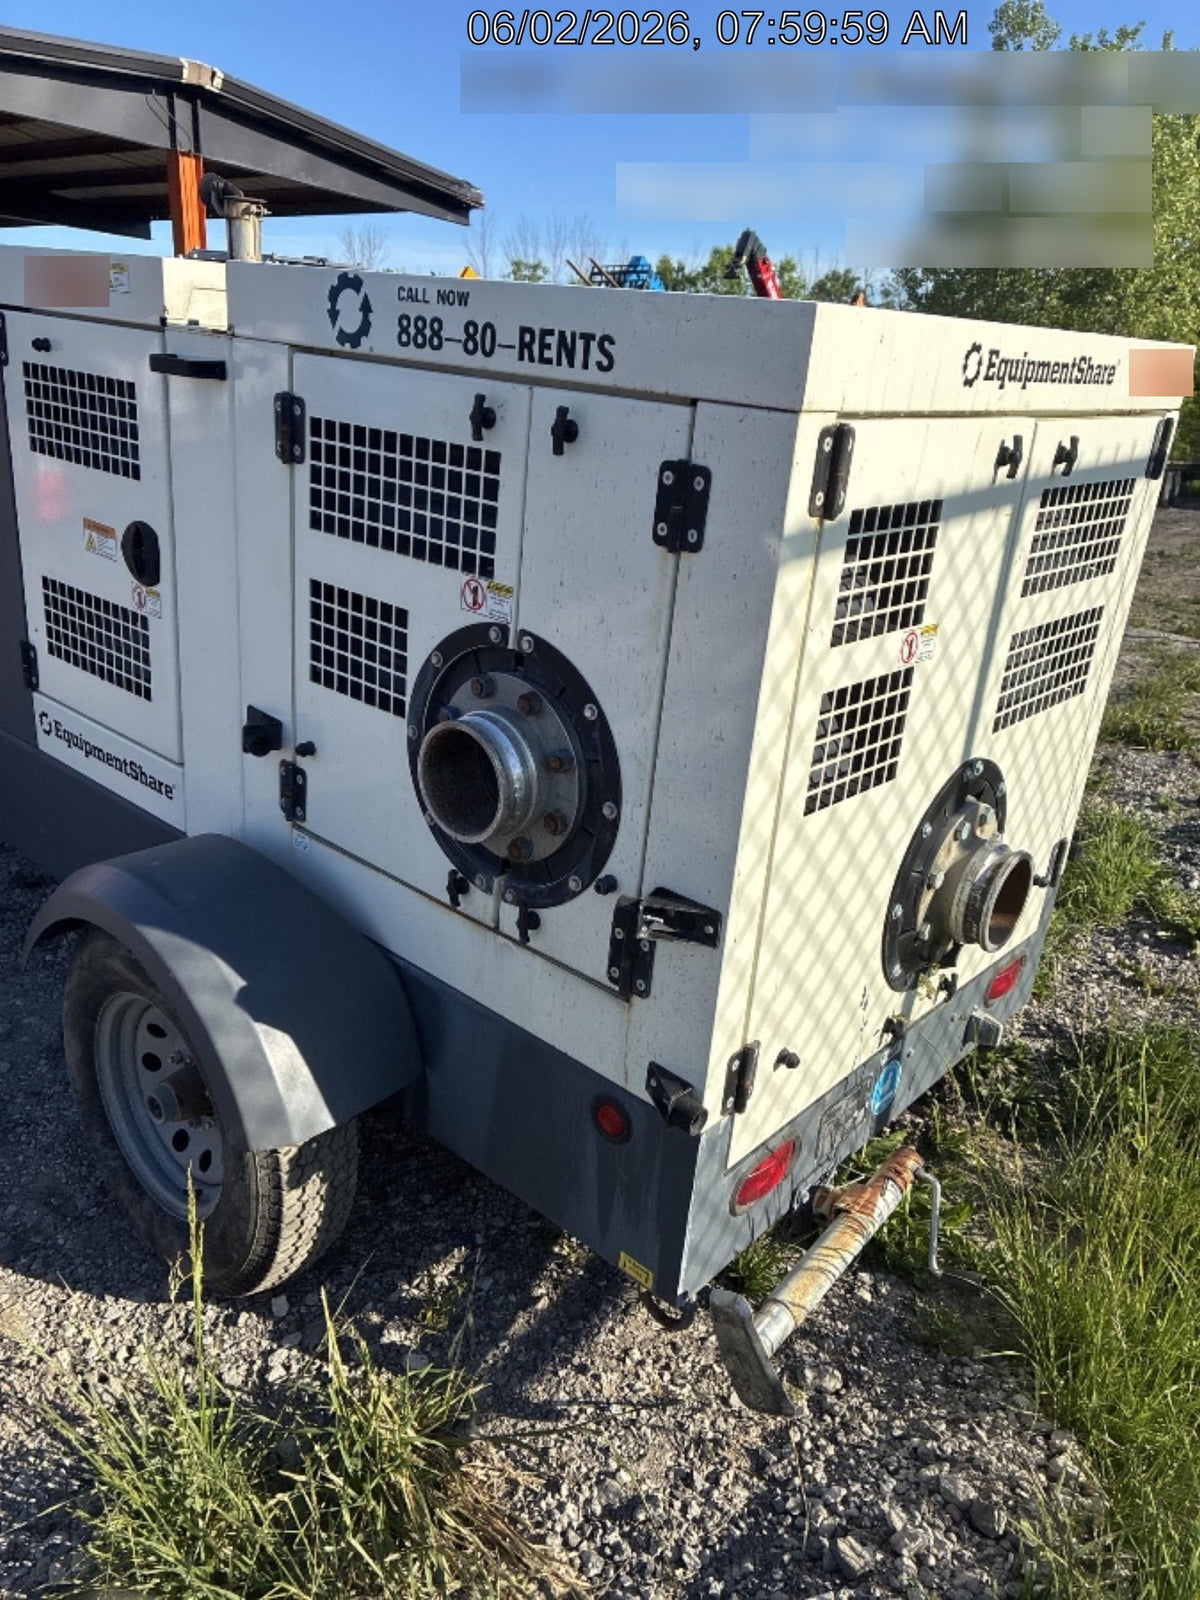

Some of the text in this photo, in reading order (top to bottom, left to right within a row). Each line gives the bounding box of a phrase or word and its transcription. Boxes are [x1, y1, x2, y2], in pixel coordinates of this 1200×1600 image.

[397, 286, 470, 307] CALL NOW
[397, 313, 616, 372] 888-80-RENTS
[983, 348, 1116, 390] EquipmentShare
[53, 719, 174, 800] EquipmentShare
